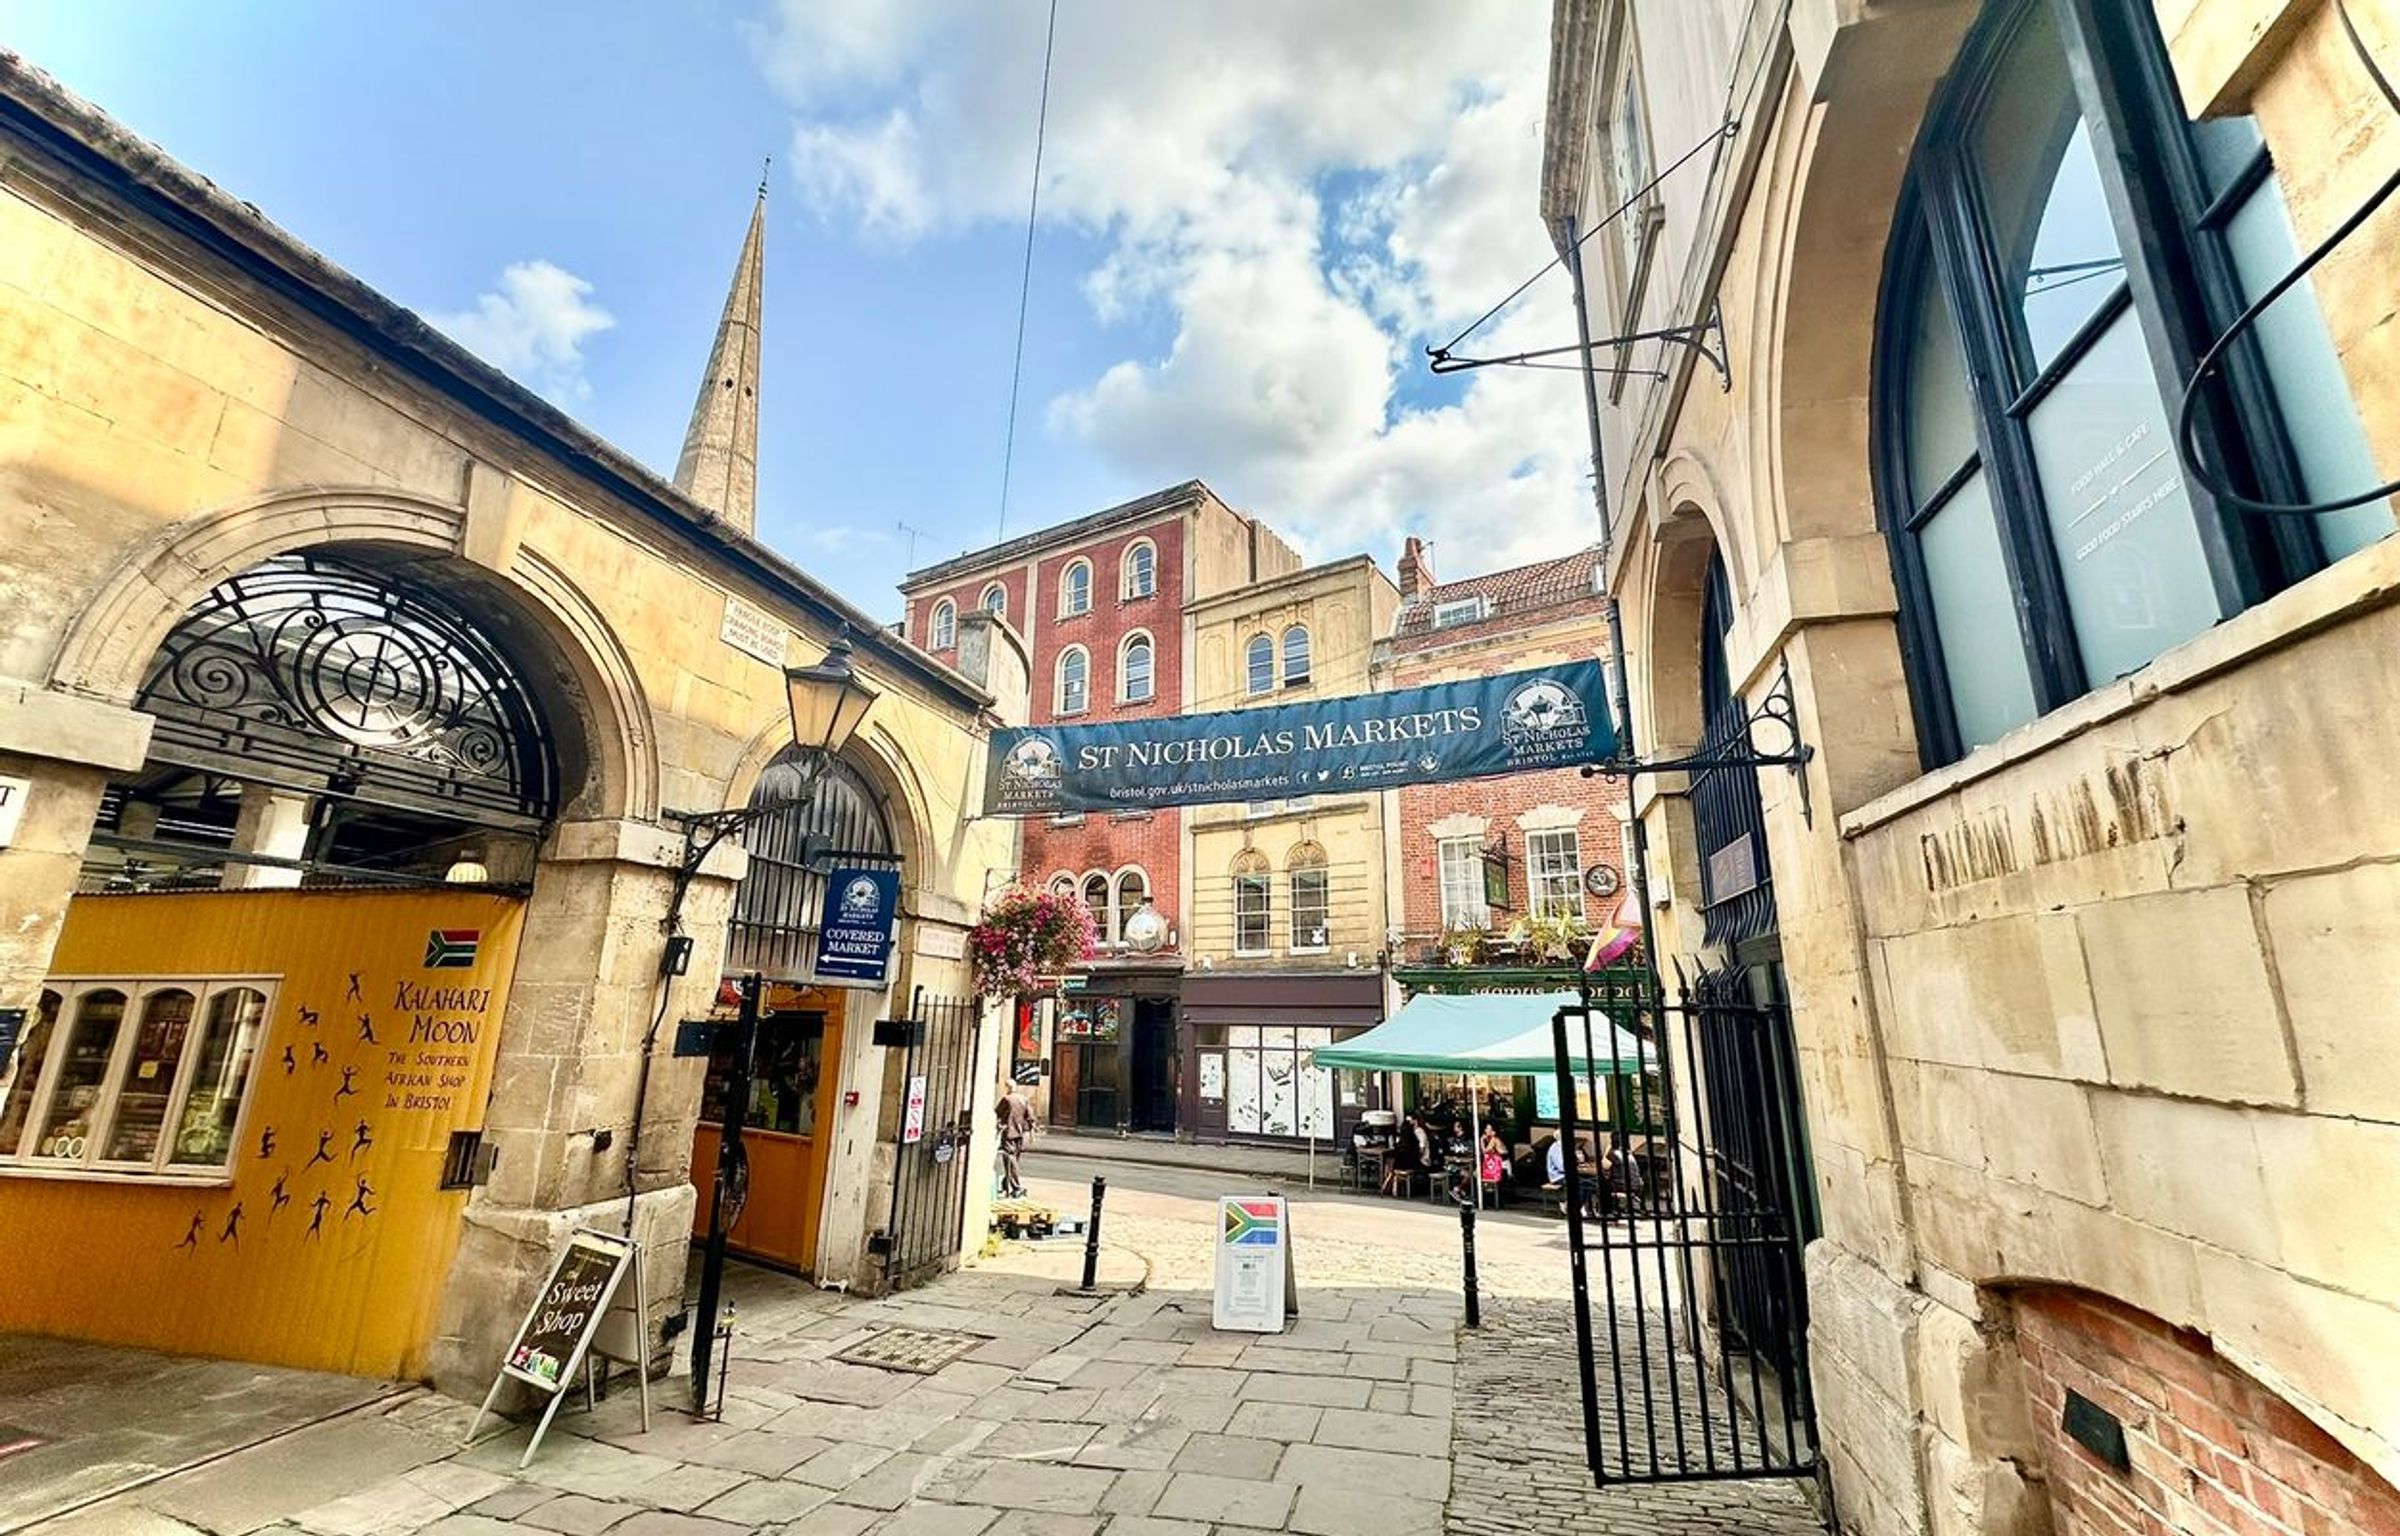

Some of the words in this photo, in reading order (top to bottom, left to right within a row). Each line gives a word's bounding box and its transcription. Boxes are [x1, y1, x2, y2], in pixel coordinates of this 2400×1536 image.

[1078, 745, 1119, 770] ST
[1126, 731, 1294, 769] NICHOLAS
[1303, 706, 1482, 751] MARKETS
[1502, 729, 1520, 745] ST
[1513, 737, 1584, 756] MARKETS
[1506, 753, 1559, 767] BRISTOL
[1109, 774, 1290, 801] bristol.gov.uk/stnicholasmarkets
[826, 928, 885, 943] COVERED
[827, 941, 880, 955] MARKET
[394, 980, 491, 1013] KALAHARI
[408, 1014, 480, 1044] MOON
[385, 1071, 431, 1086] AFRICAN
[439, 1073, 466, 1088] SHOP
[385, 1093, 397, 1108] IN
[547, 1280, 603, 1305] Sweet
[536, 1311, 585, 1336] Shop
